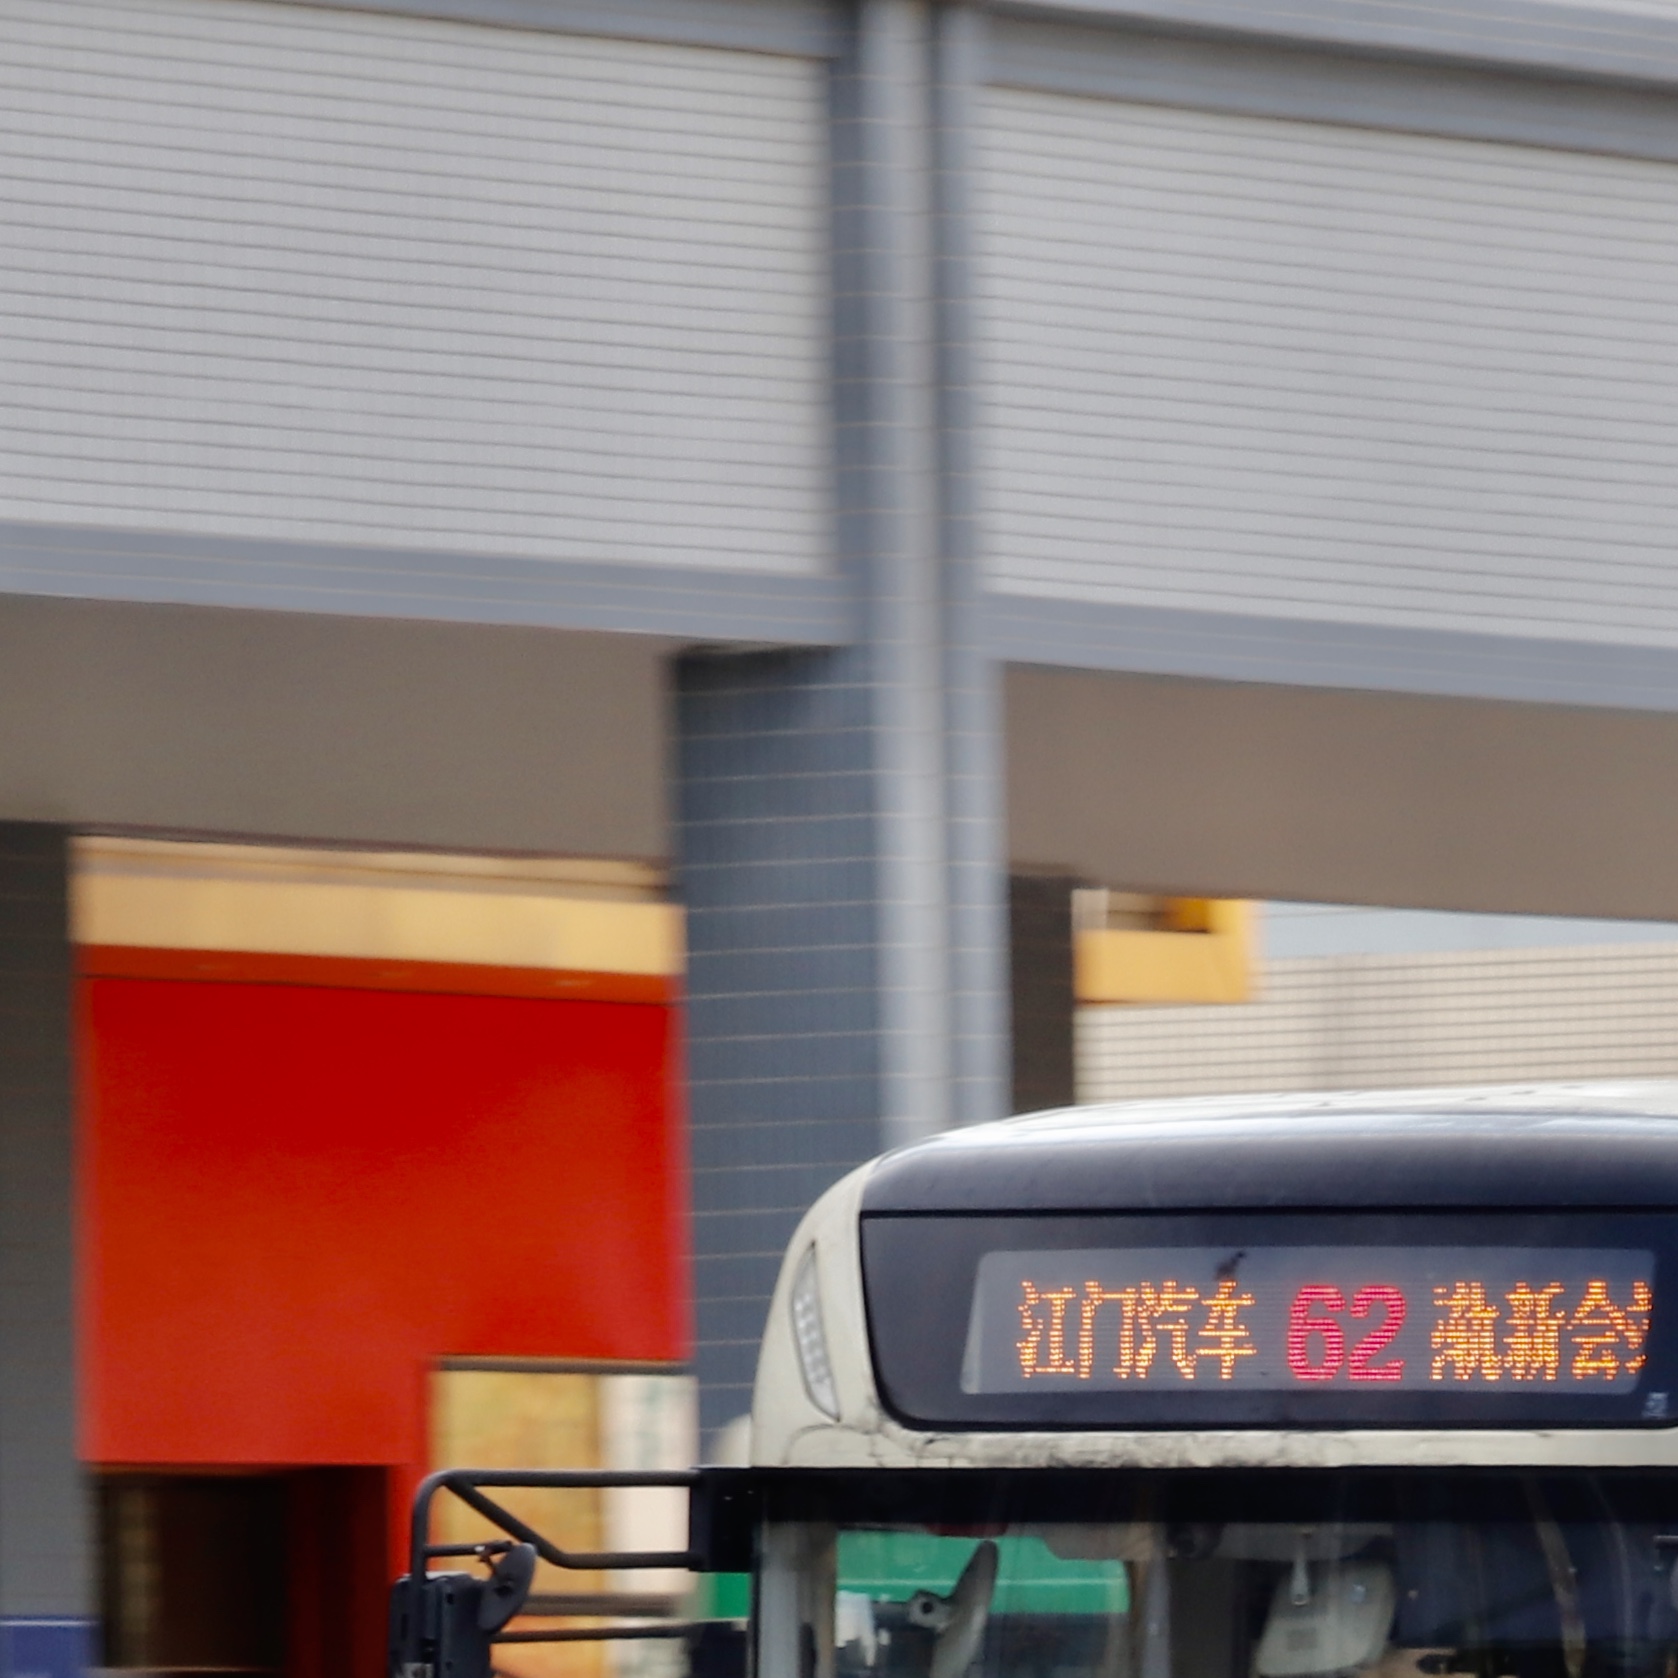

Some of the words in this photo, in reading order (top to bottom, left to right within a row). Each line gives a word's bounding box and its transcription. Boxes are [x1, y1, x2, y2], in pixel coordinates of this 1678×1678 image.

[1016, 1281, 1256, 1379] 江门汽车
[1284, 1283, 1407, 1382] 62
